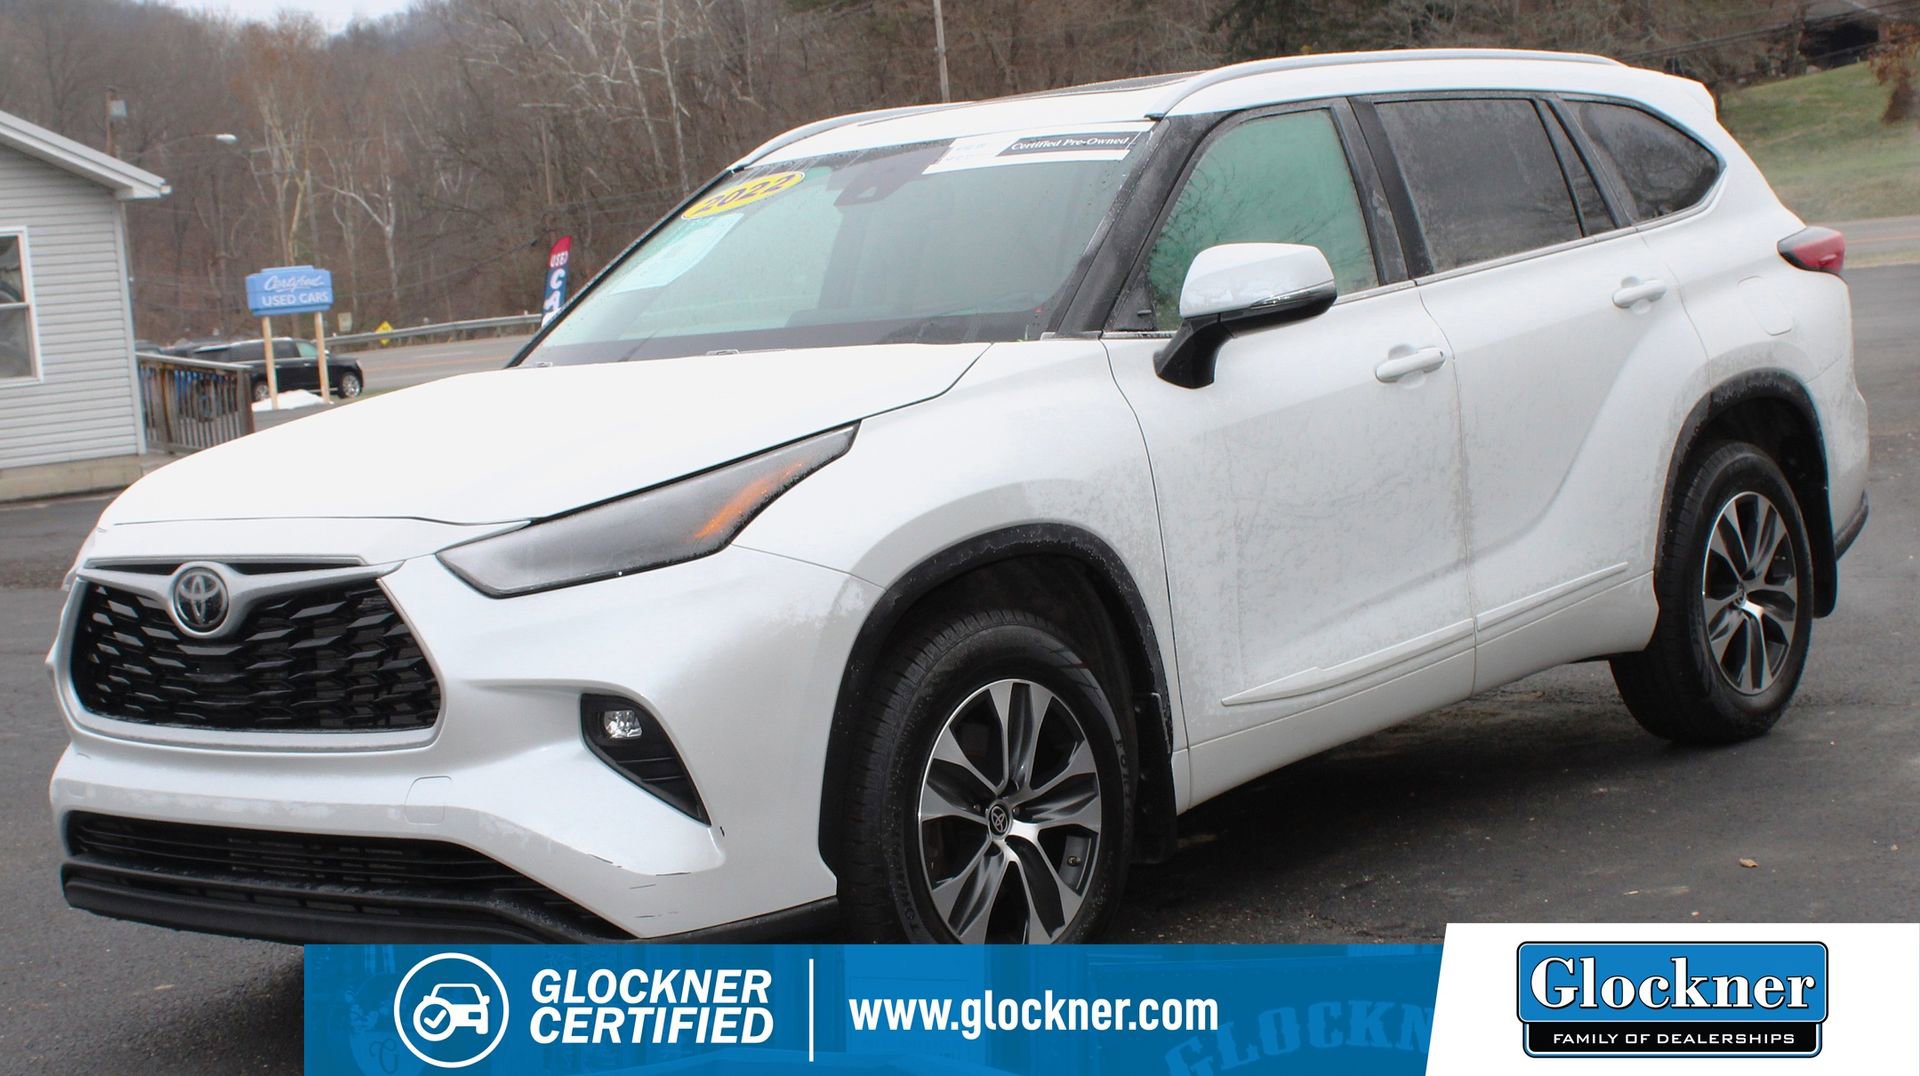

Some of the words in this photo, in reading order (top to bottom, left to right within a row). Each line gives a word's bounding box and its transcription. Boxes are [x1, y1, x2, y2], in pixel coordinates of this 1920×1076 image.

[1011, 139, 1062, 151] Certified
[1063, 136, 1130, 147] Pre-Owned
[691, 174, 796, 217] 2022
[264, 275, 324, 293] Certified
[261, 294, 297, 307] USED
[299, 291, 329, 304] CARS
